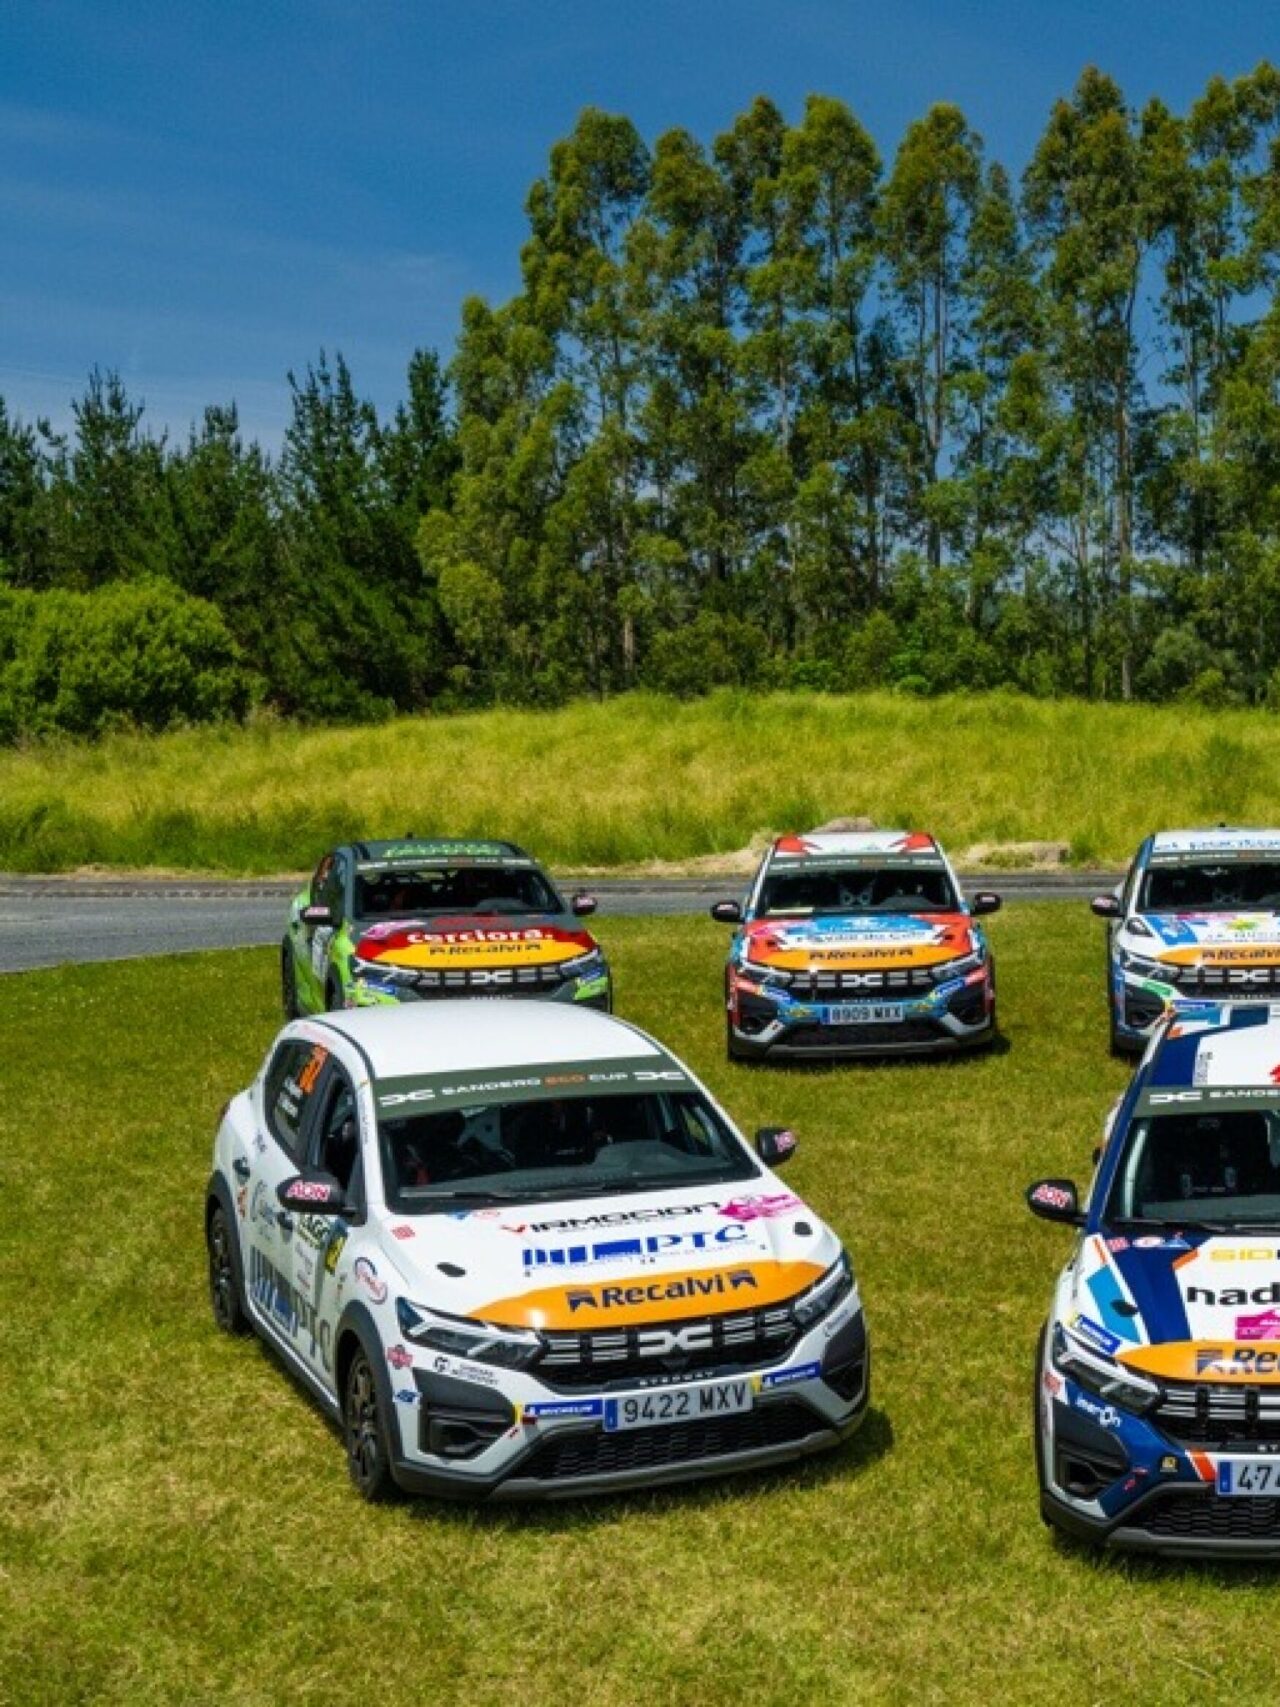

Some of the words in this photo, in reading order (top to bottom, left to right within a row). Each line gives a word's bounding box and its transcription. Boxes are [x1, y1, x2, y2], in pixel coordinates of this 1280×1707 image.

[827, 947, 896, 960] Recalvi
[1217, 948, 1280, 960] Recalvi
[442, 1077, 541, 1096] SANDERO
[544, 1072, 586, 1086] ECO
[589, 1071, 628, 1083] CUP
[646, 1224, 748, 1254] PTC
[602, 1273, 725, 1309] Recalvi
[623, 1392, 690, 1423] 9422
[699, 1382, 747, 1413] MXV
